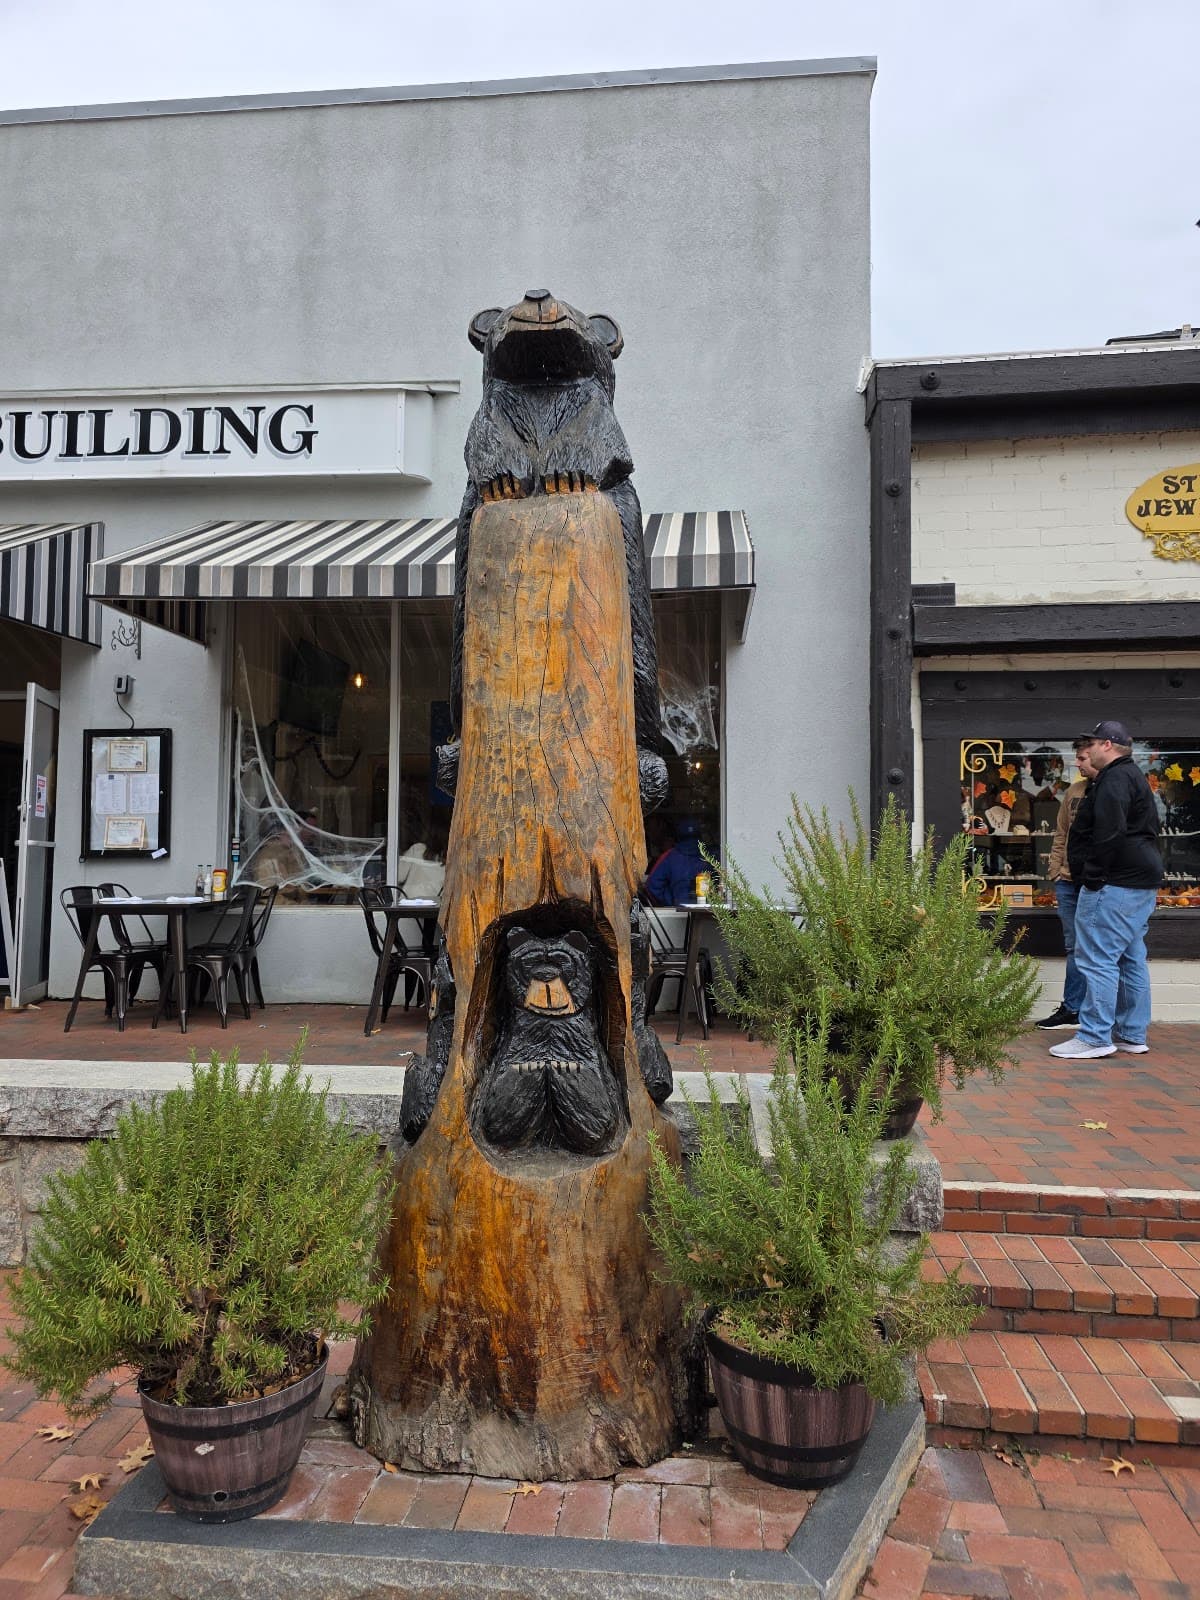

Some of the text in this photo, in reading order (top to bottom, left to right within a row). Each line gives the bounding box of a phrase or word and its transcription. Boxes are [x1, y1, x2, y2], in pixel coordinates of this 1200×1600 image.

[0, 404, 319, 460] UILDING
[1162, 475, 1200, 494] ST
[1136, 498, 1200, 517] JEW
